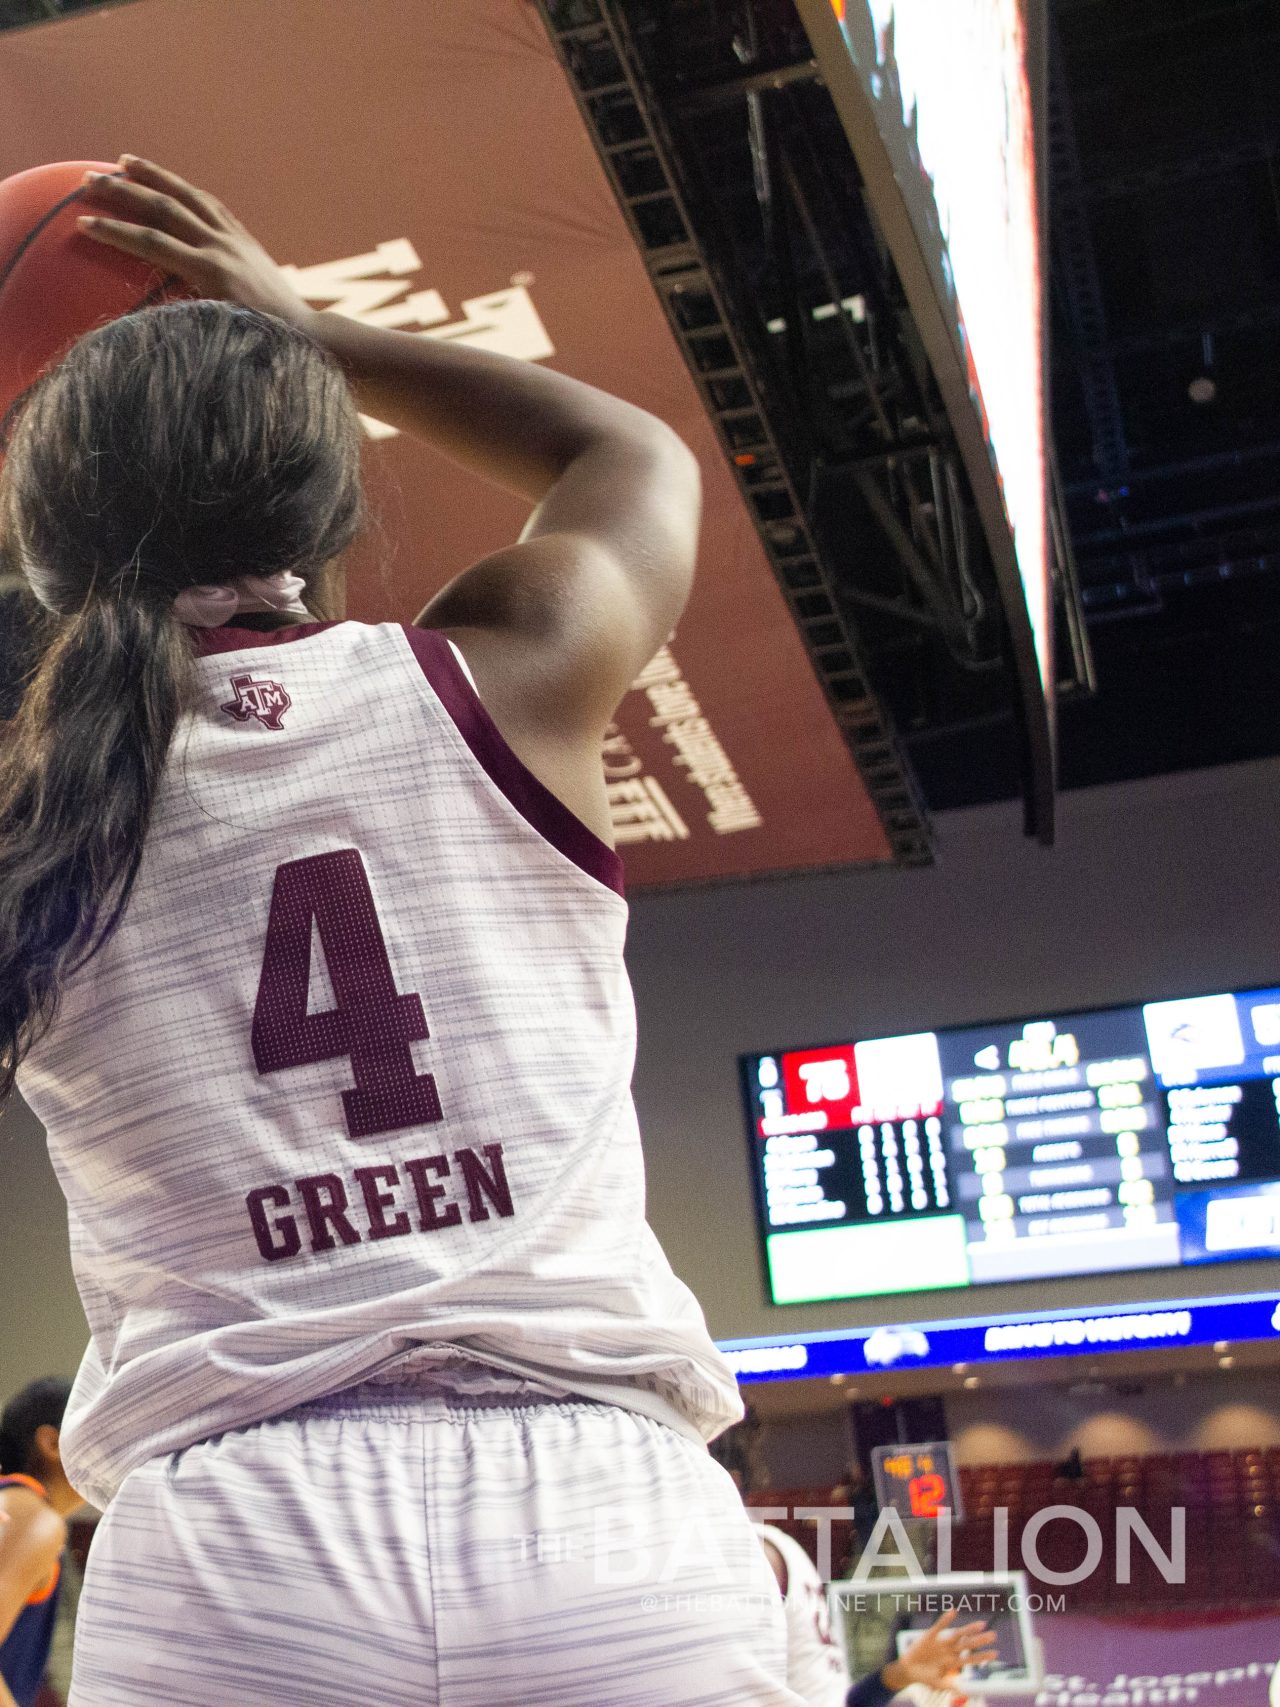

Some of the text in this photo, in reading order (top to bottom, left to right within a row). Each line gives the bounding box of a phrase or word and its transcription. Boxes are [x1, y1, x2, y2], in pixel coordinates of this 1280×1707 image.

[252, 848, 444, 1138] 4
[246, 1143, 514, 1262] GREEN
[1035, 1687, 1198, 1706] Health
